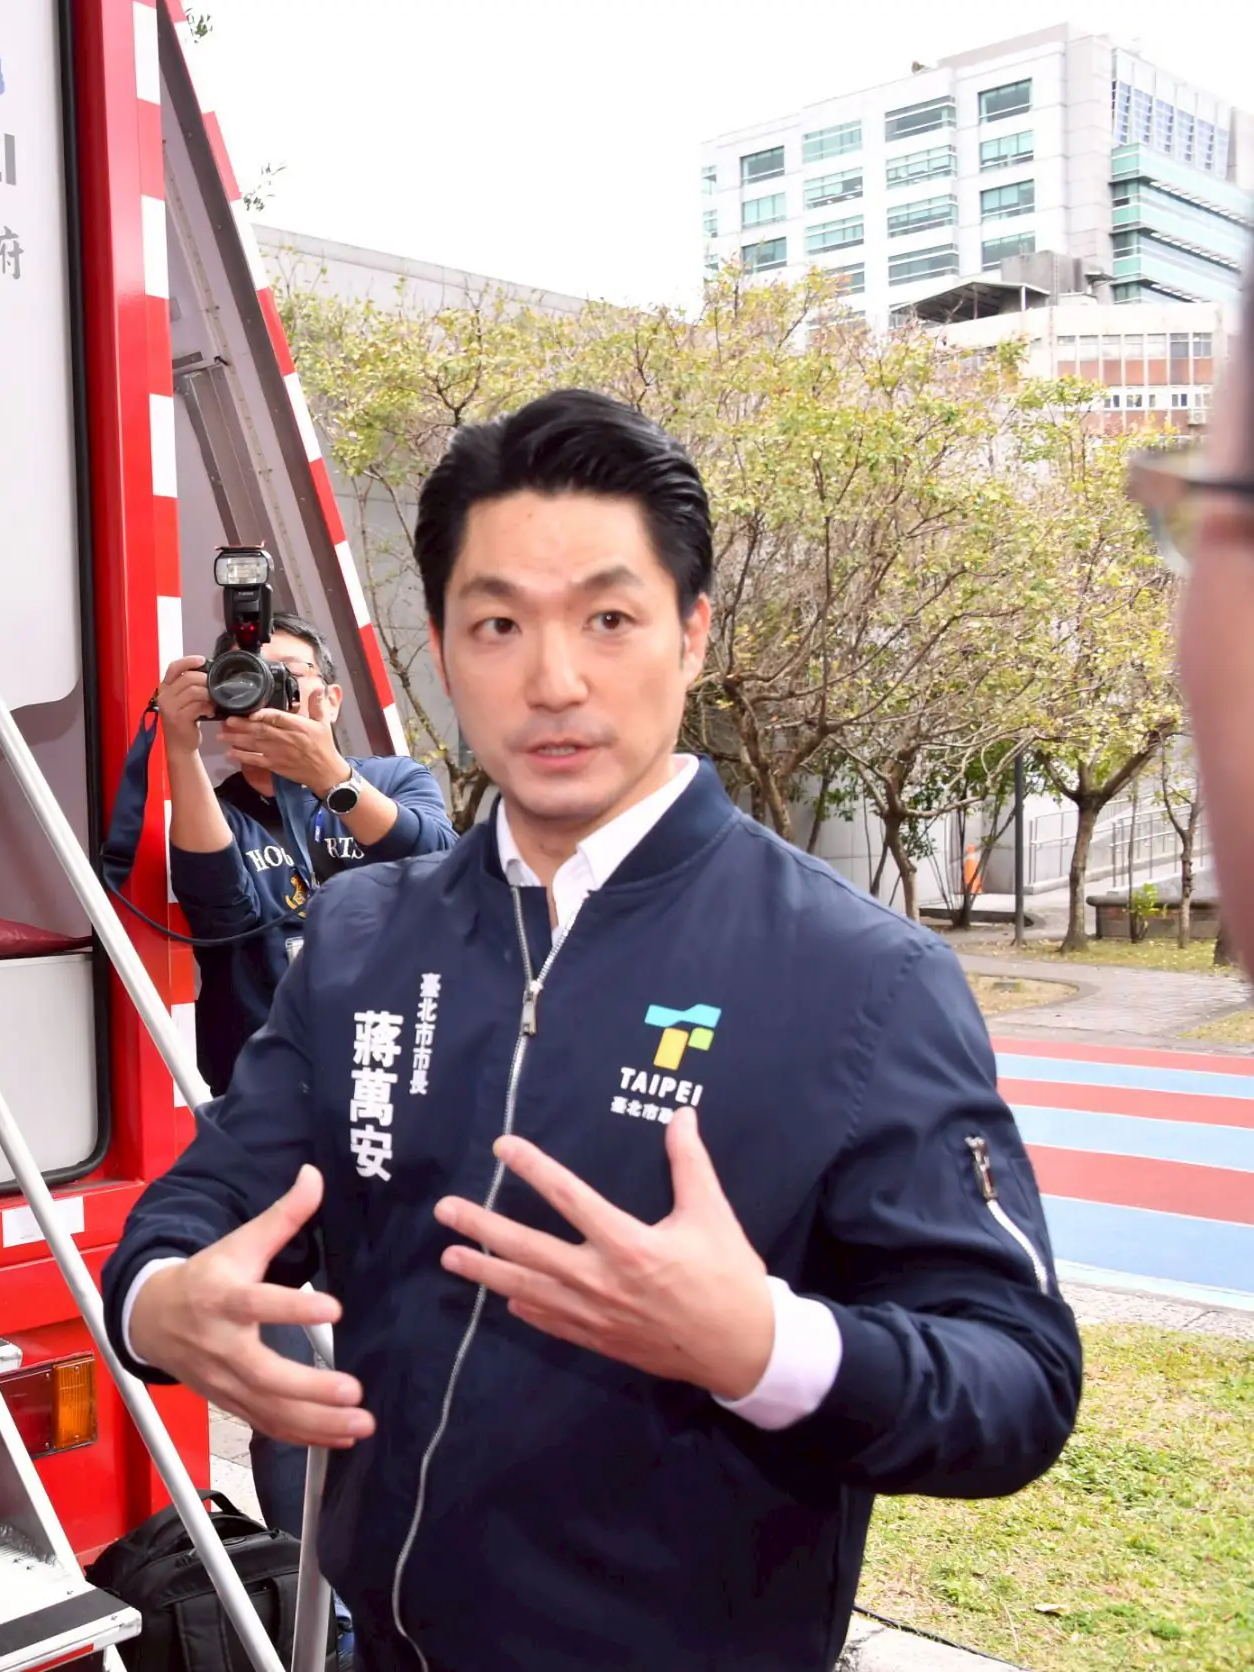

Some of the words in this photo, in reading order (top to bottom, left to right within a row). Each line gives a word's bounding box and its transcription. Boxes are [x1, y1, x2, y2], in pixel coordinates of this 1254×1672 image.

[409, 972, 442, 1095] 臺北市市長
[620, 1066, 704, 1107] TAIPEI
[349, 1010, 404, 1182] 蔣萬安
